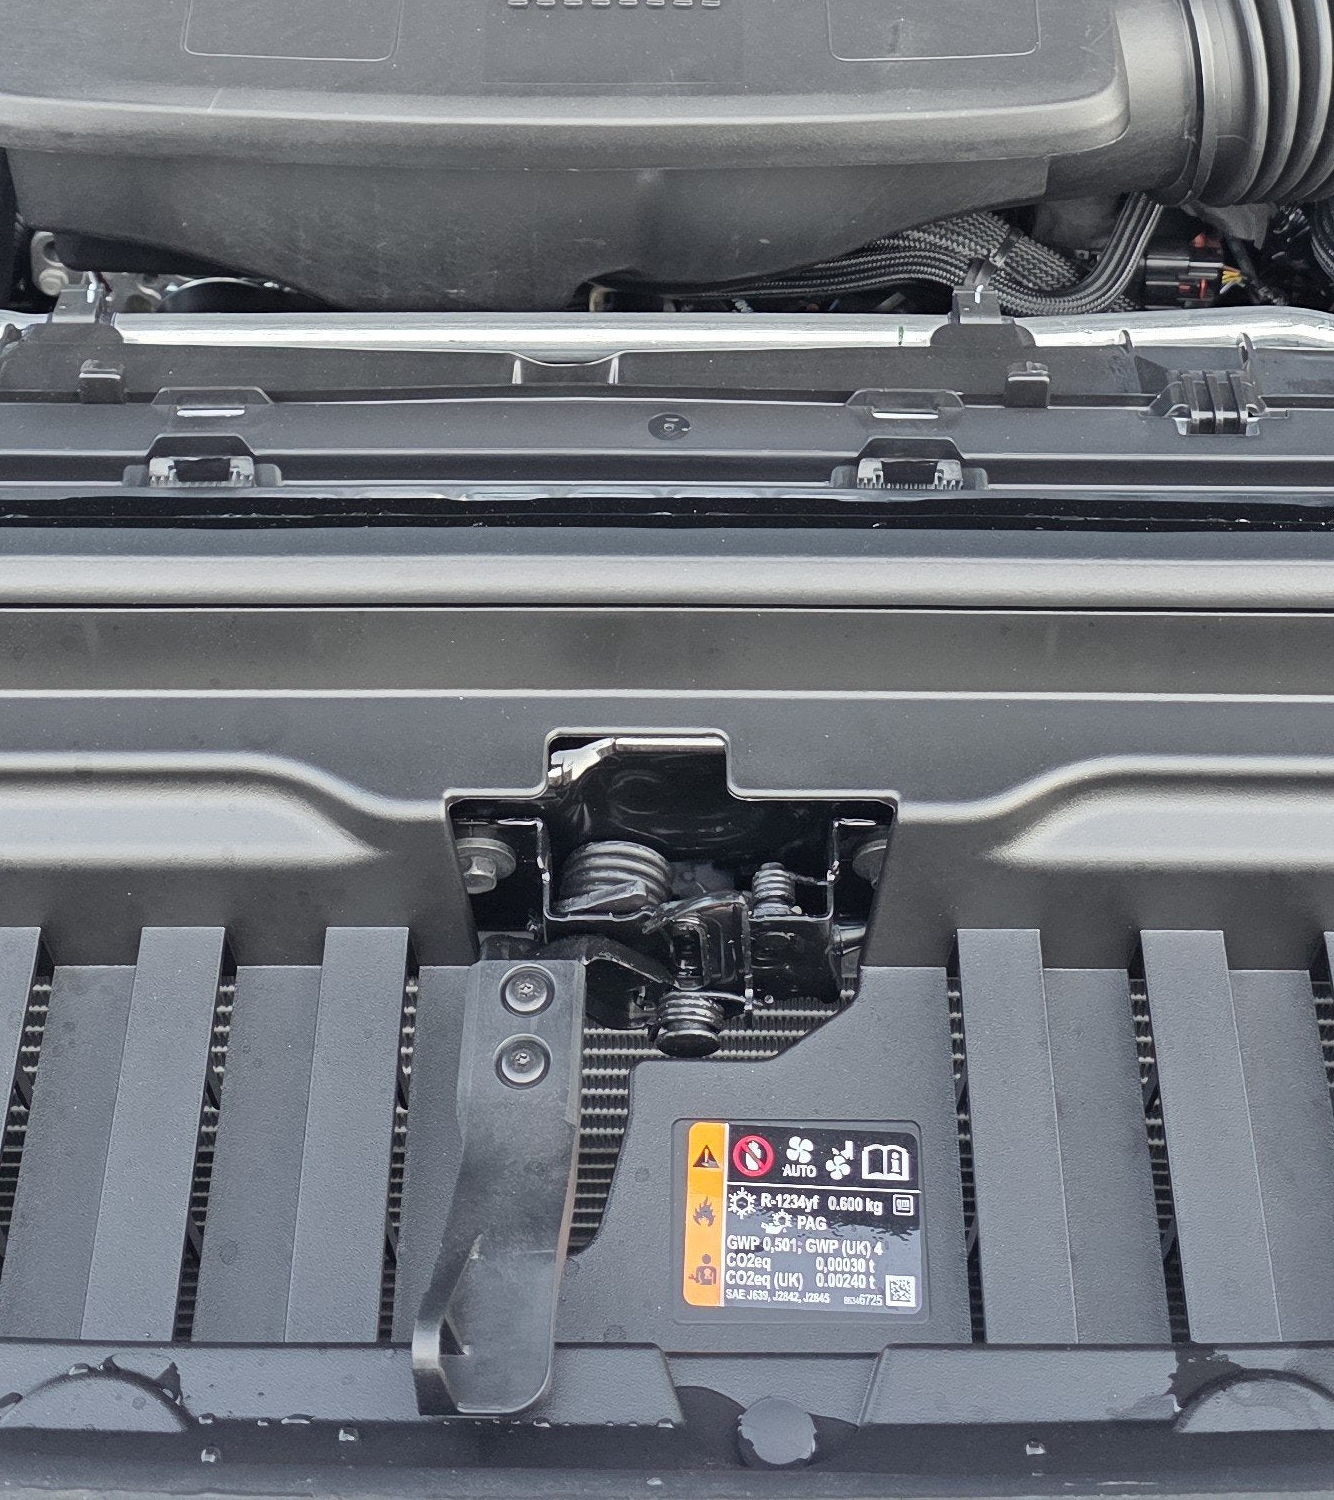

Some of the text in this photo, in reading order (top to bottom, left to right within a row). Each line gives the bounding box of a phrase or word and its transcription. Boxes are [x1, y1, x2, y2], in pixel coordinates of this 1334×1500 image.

[783, 1164, 816, 1177] AUTO
[760, 1193, 883, 1215] R-1234yf 0.600 kg
[797, 1216, 827, 1230] PAG
[727, 1235, 760, 1250] GWP
[805, 1239, 839, 1253] GWP
[841, 1240, 871, 1258] (UK)
[873, 1242, 883, 1256] 4
[726, 1253, 771, 1271] CO2eq
[868, 1258, 875, 1273] t
[725, 1269, 770, 1288] CO2eq
[774, 1272, 803, 1290] (UK)
[869, 1274, 876, 1289] t
[725, 1289, 746, 1300] SAE
